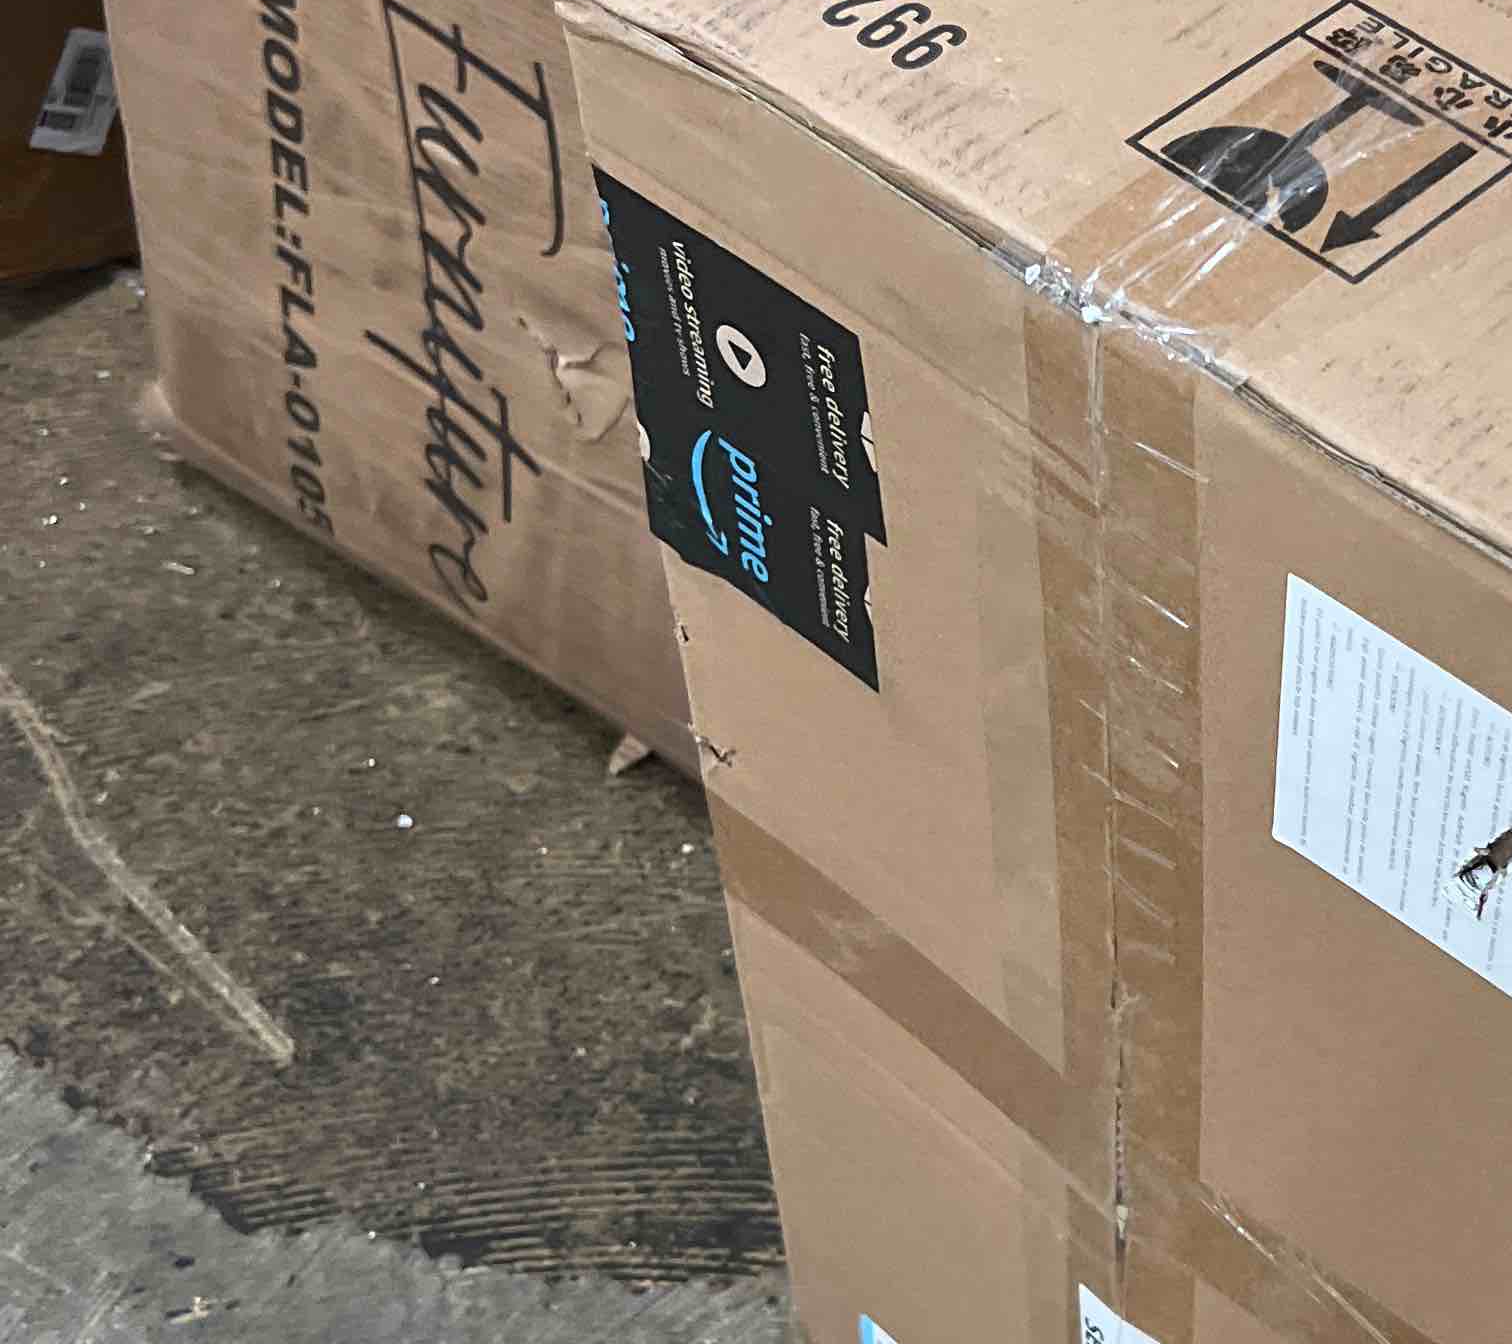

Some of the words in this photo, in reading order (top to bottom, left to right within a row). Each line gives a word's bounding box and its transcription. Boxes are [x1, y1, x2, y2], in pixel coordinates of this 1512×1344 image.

[668, 294, 683, 322] and
[676, 337, 691, 376] shows
[672, 241, 695, 300] video
[684, 302, 714, 408] streaming
[817, 345, 836, 393] free
[804, 364, 817, 391] free
[811, 405, 830, 475] convenient
[825, 396, 850, 489] delivery
[717, 432, 773, 585] prime
[826, 519, 845, 561] free
[831, 563, 851, 644] delivery
